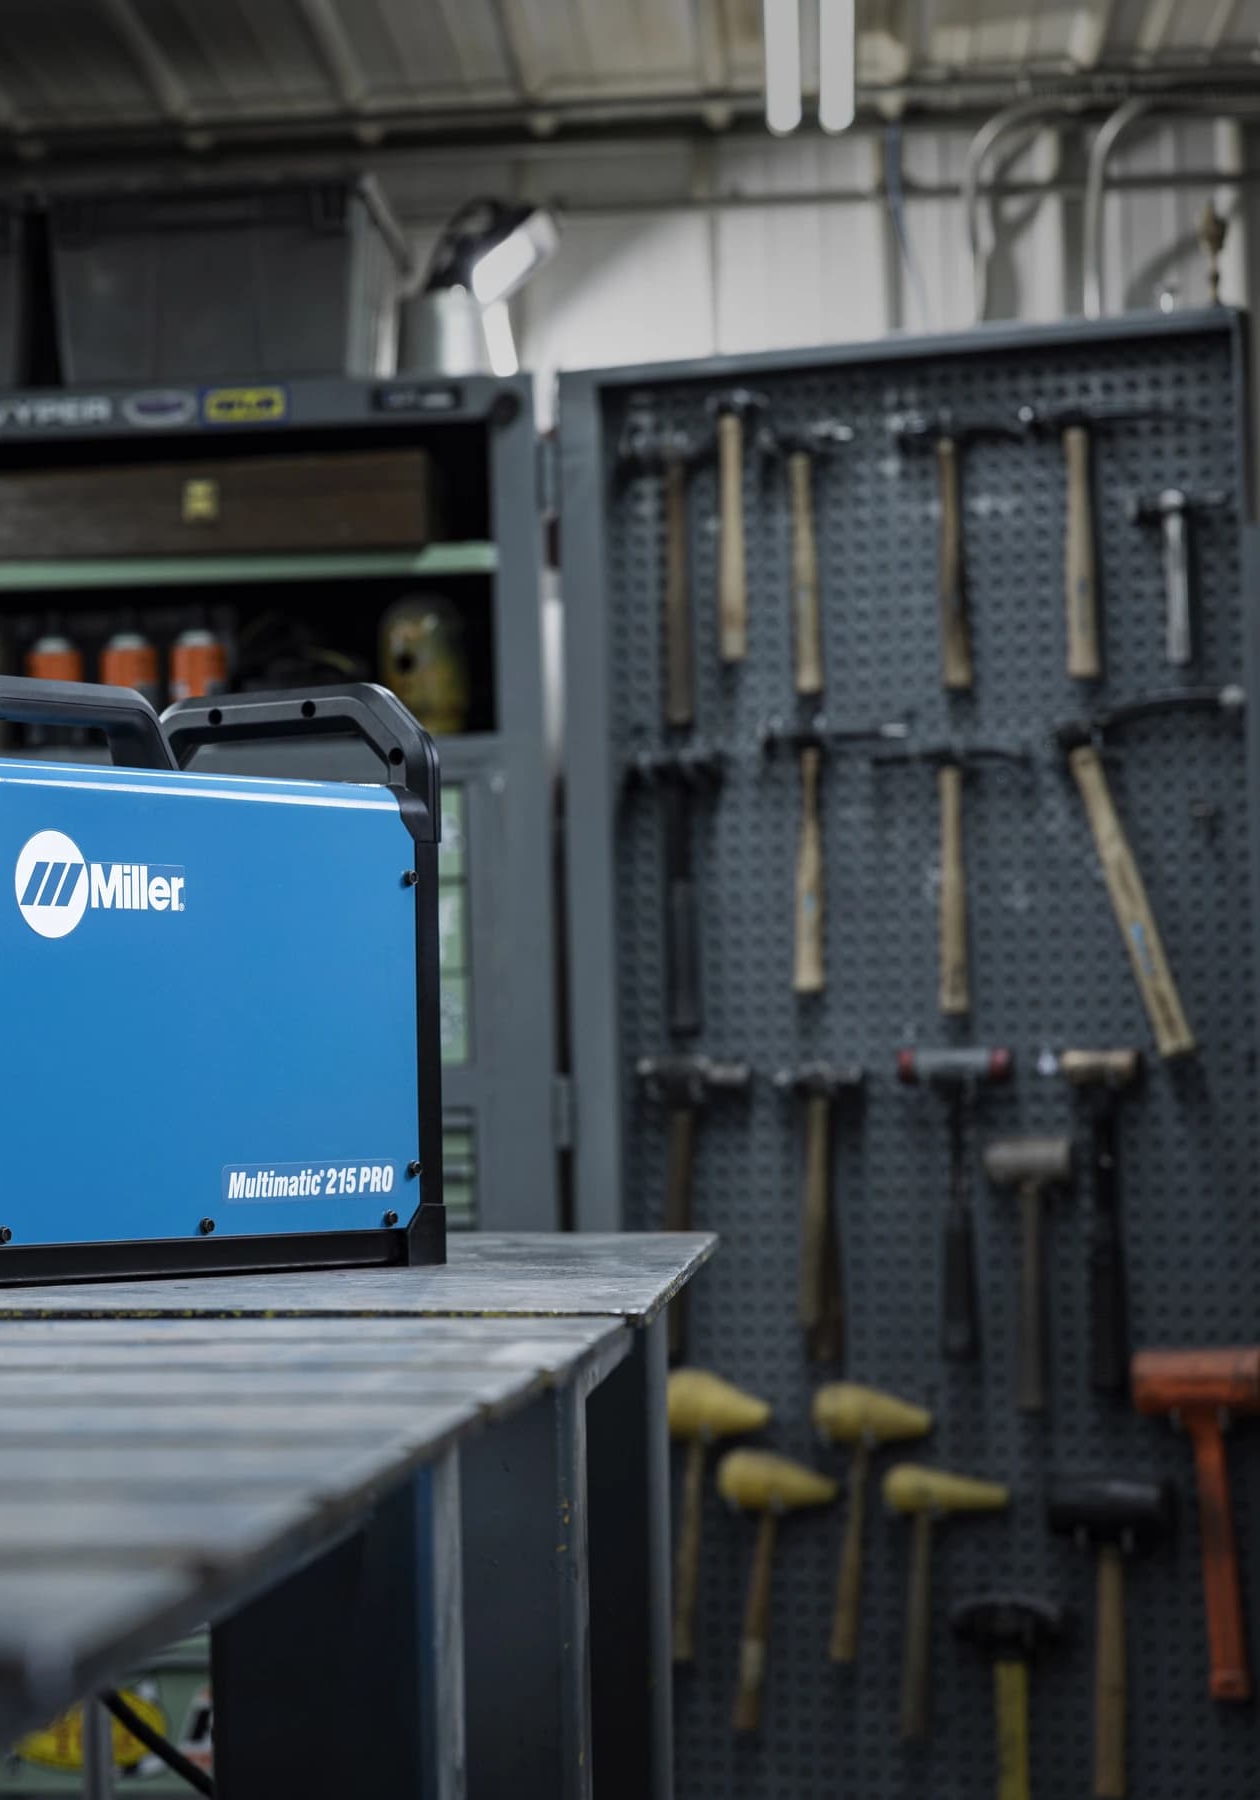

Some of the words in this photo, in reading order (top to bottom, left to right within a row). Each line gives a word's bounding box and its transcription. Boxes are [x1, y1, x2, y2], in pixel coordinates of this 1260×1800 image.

[90, 863, 185, 911] Miller
[325, 1167, 356, 1195] 215
[358, 1165, 394, 1193] PRO
